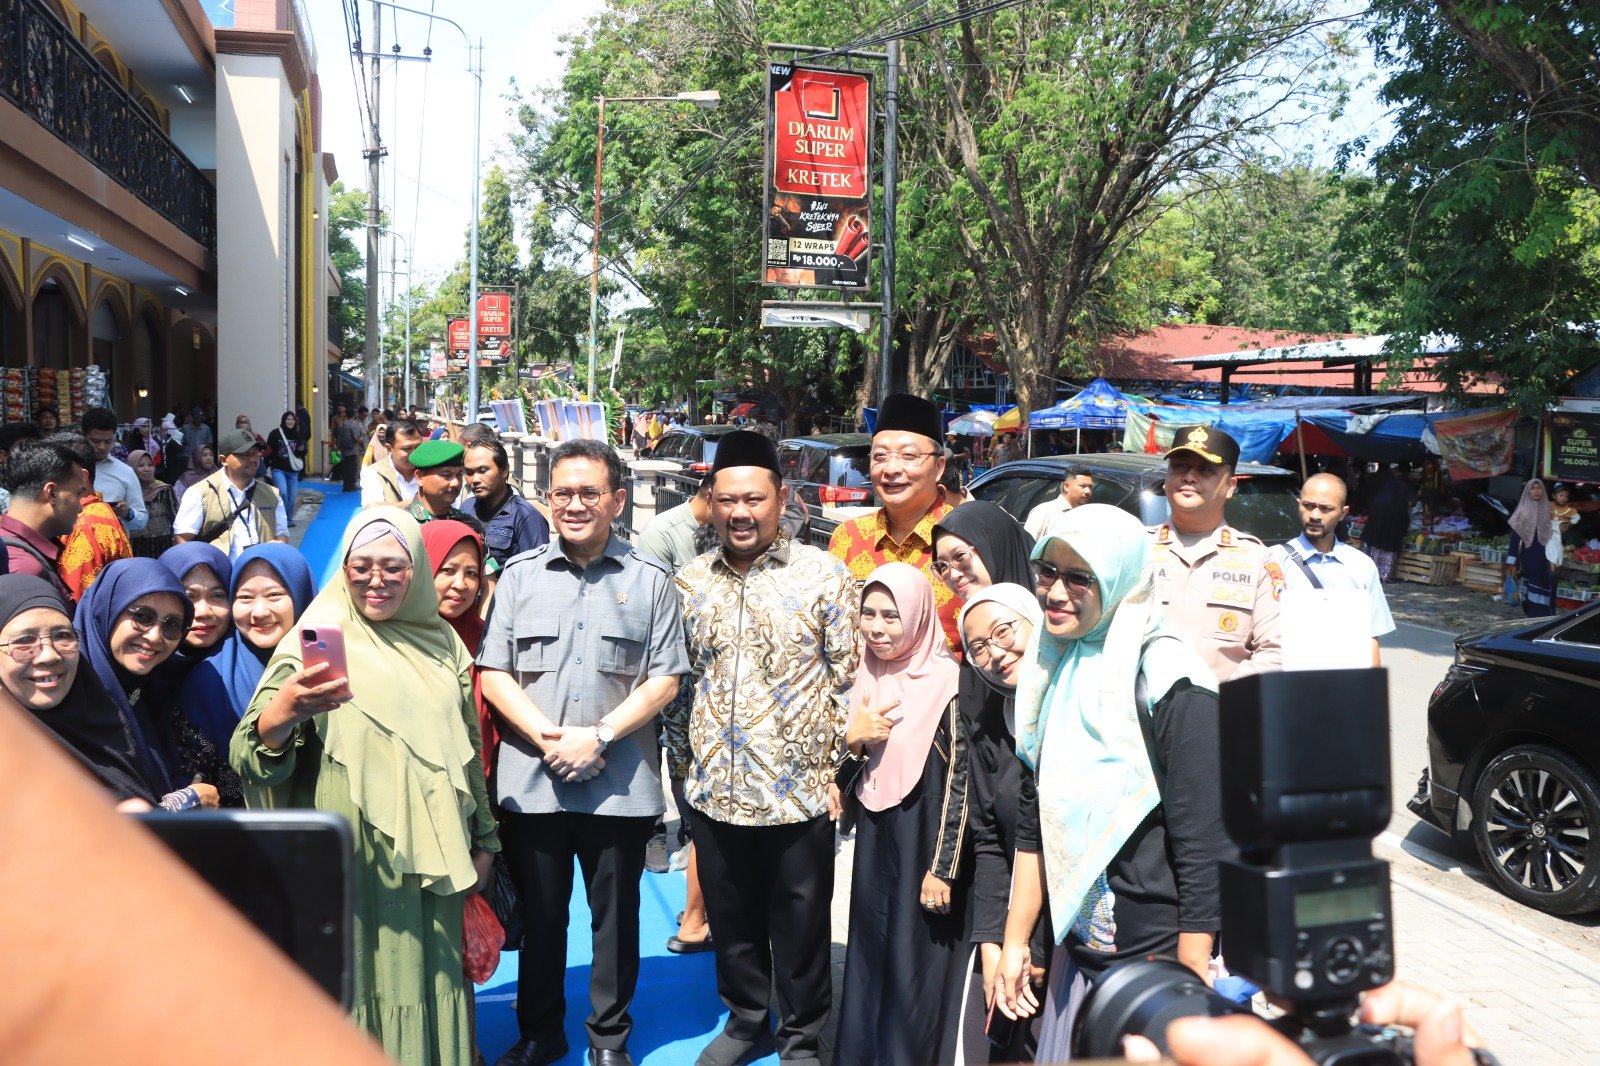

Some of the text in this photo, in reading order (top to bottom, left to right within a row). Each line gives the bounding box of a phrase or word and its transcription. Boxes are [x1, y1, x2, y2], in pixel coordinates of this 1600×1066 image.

[788, 121, 855, 142] DJARUM
[795, 139, 846, 158] SUPER
[788, 168, 853, 188] KRETEK
[793, 240, 835, 252] 12 WRAPS
[792, 254, 802, 263] Rp
[1567, 438, 1592, 446] SUPER
[1561, 445, 1598, 455] PREMIUM
[1212, 571, 1251, 583] POLRI
